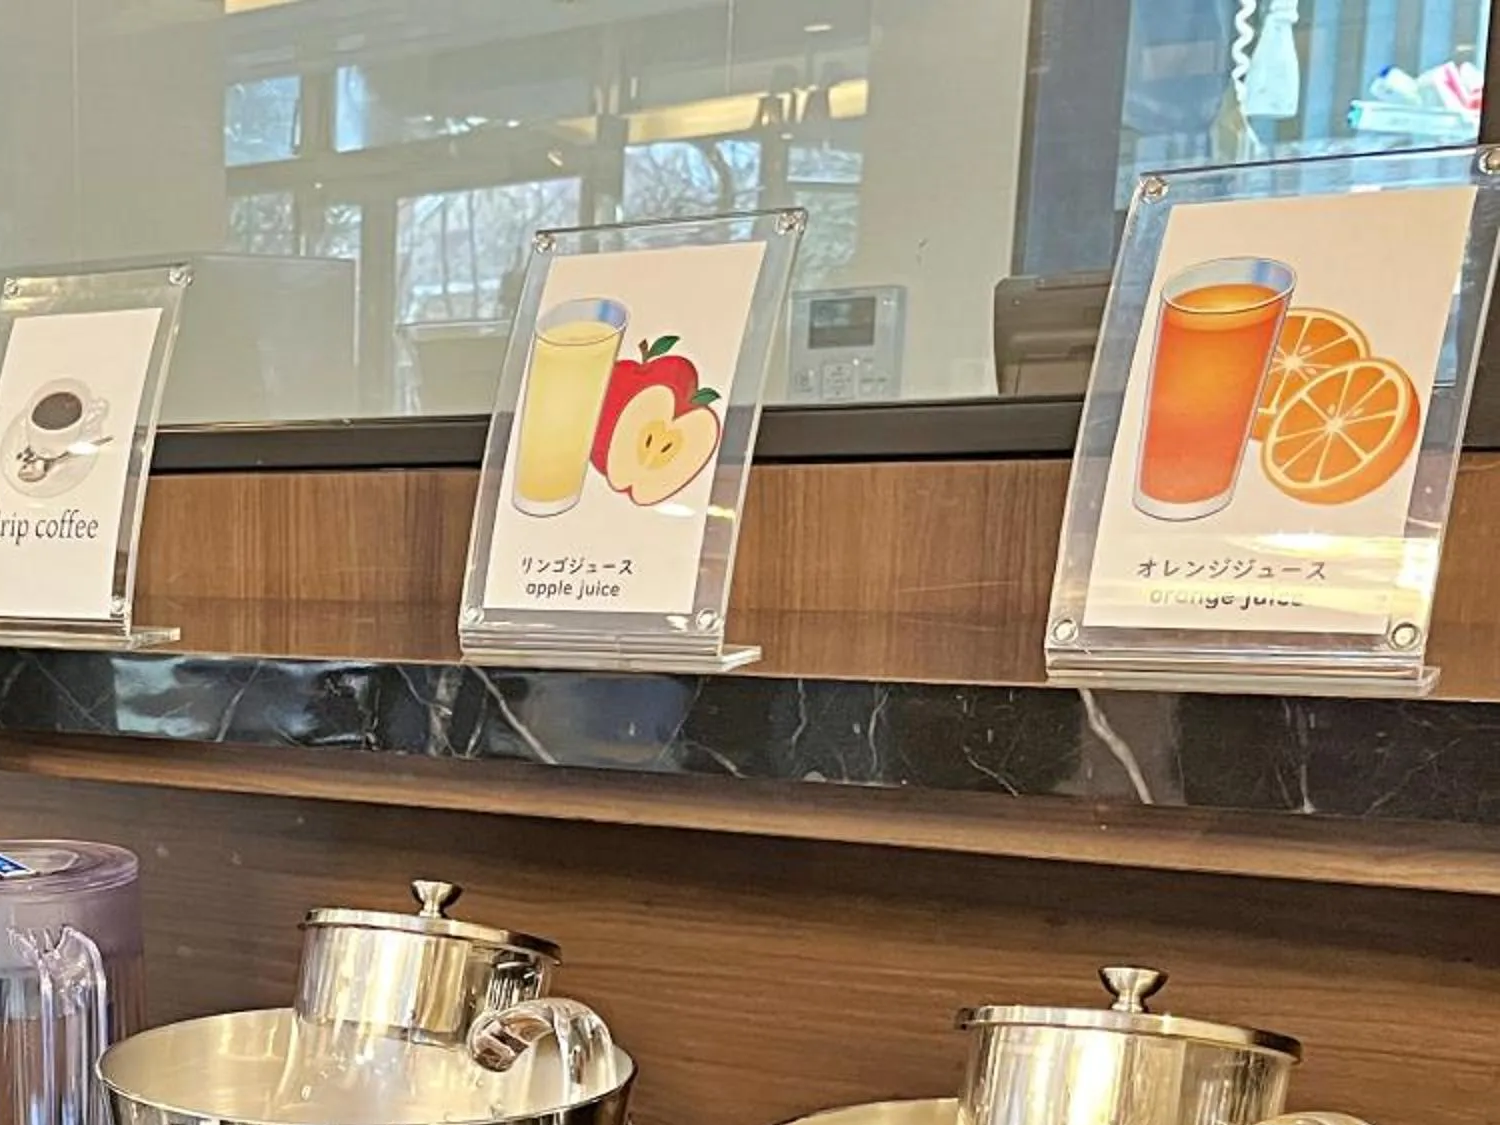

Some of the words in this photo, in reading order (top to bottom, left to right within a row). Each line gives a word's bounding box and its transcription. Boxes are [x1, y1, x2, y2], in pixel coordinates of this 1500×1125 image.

[35, 508, 99, 539] coffee
[521, 556, 633, 575] リンゴジュース
[1137, 558, 1327, 581] オレンジジュース
[525, 579, 573, 599] apple
[575, 579, 621, 600] juice
